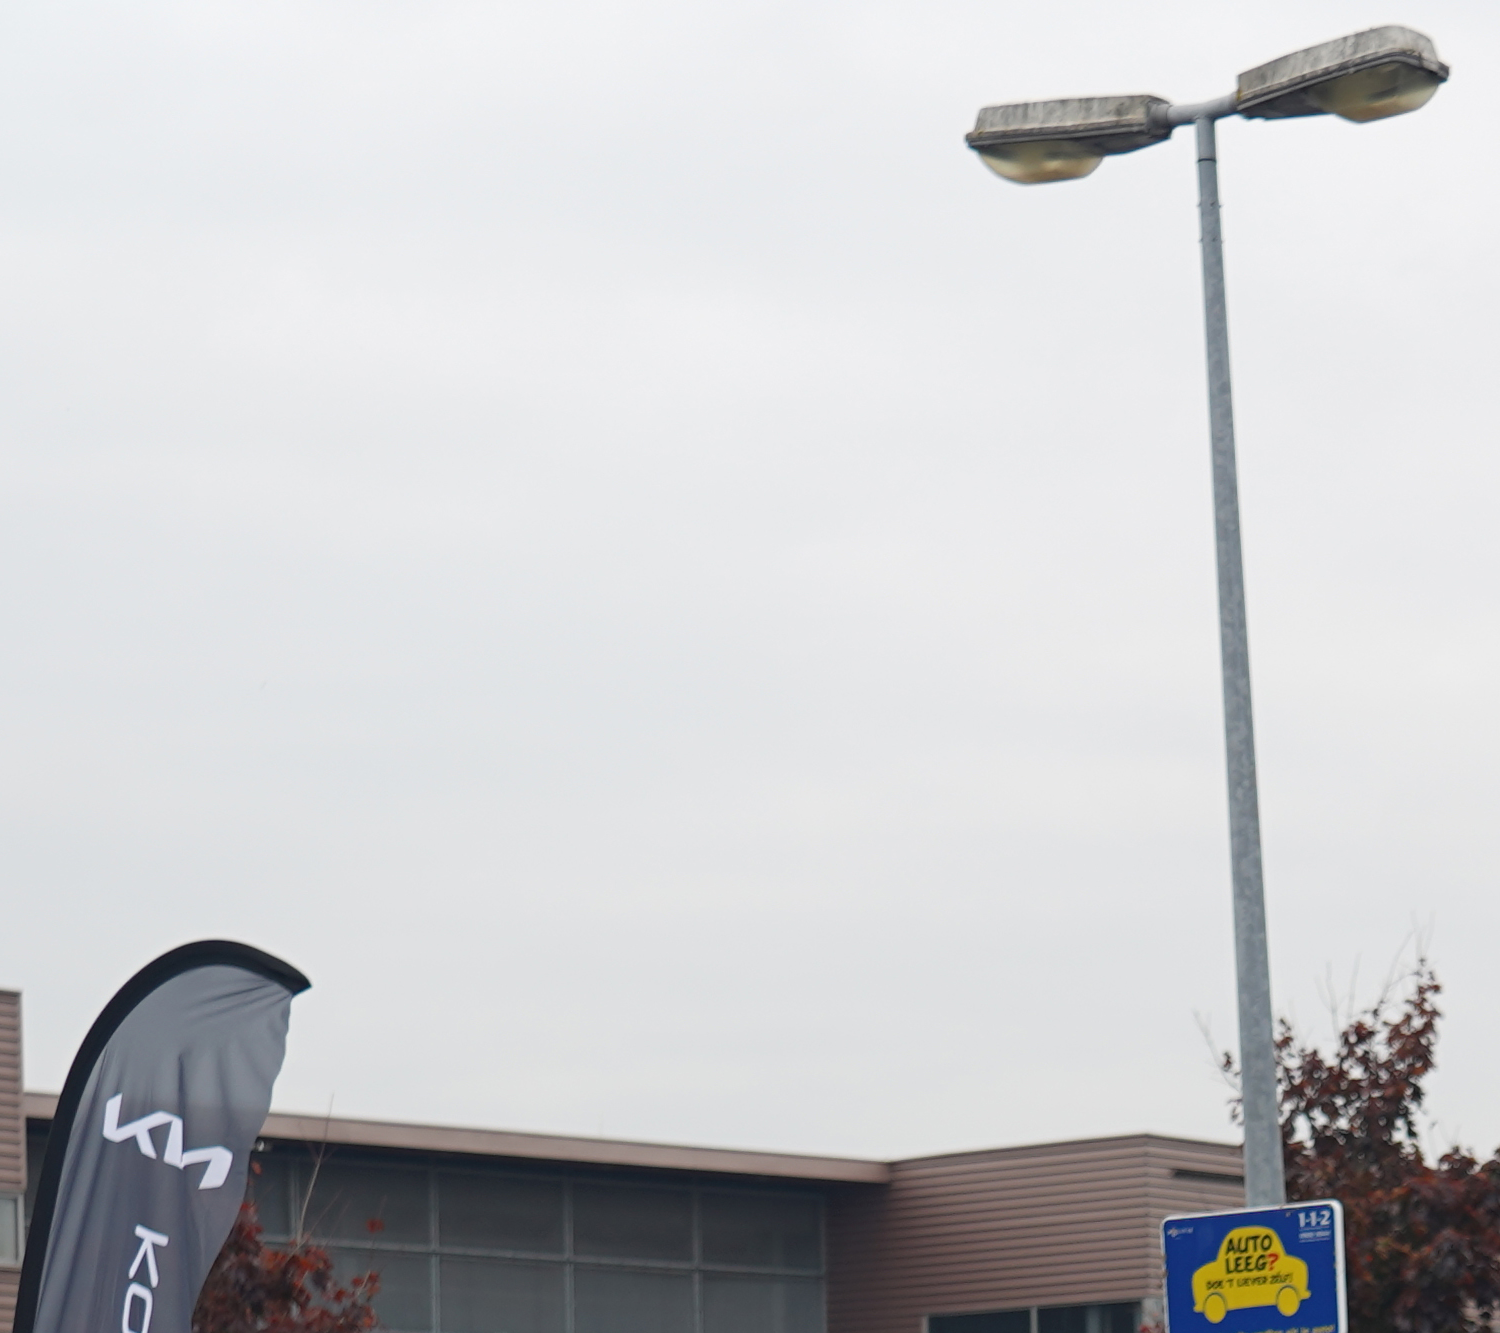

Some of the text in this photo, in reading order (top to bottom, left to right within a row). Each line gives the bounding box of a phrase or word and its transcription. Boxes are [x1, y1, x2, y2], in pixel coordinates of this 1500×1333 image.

[103, 1092, 234, 1190] KIA
[1225, 1234, 1273, 1255] AUTO
[1225, 1253, 1280, 1275] LEEG?
